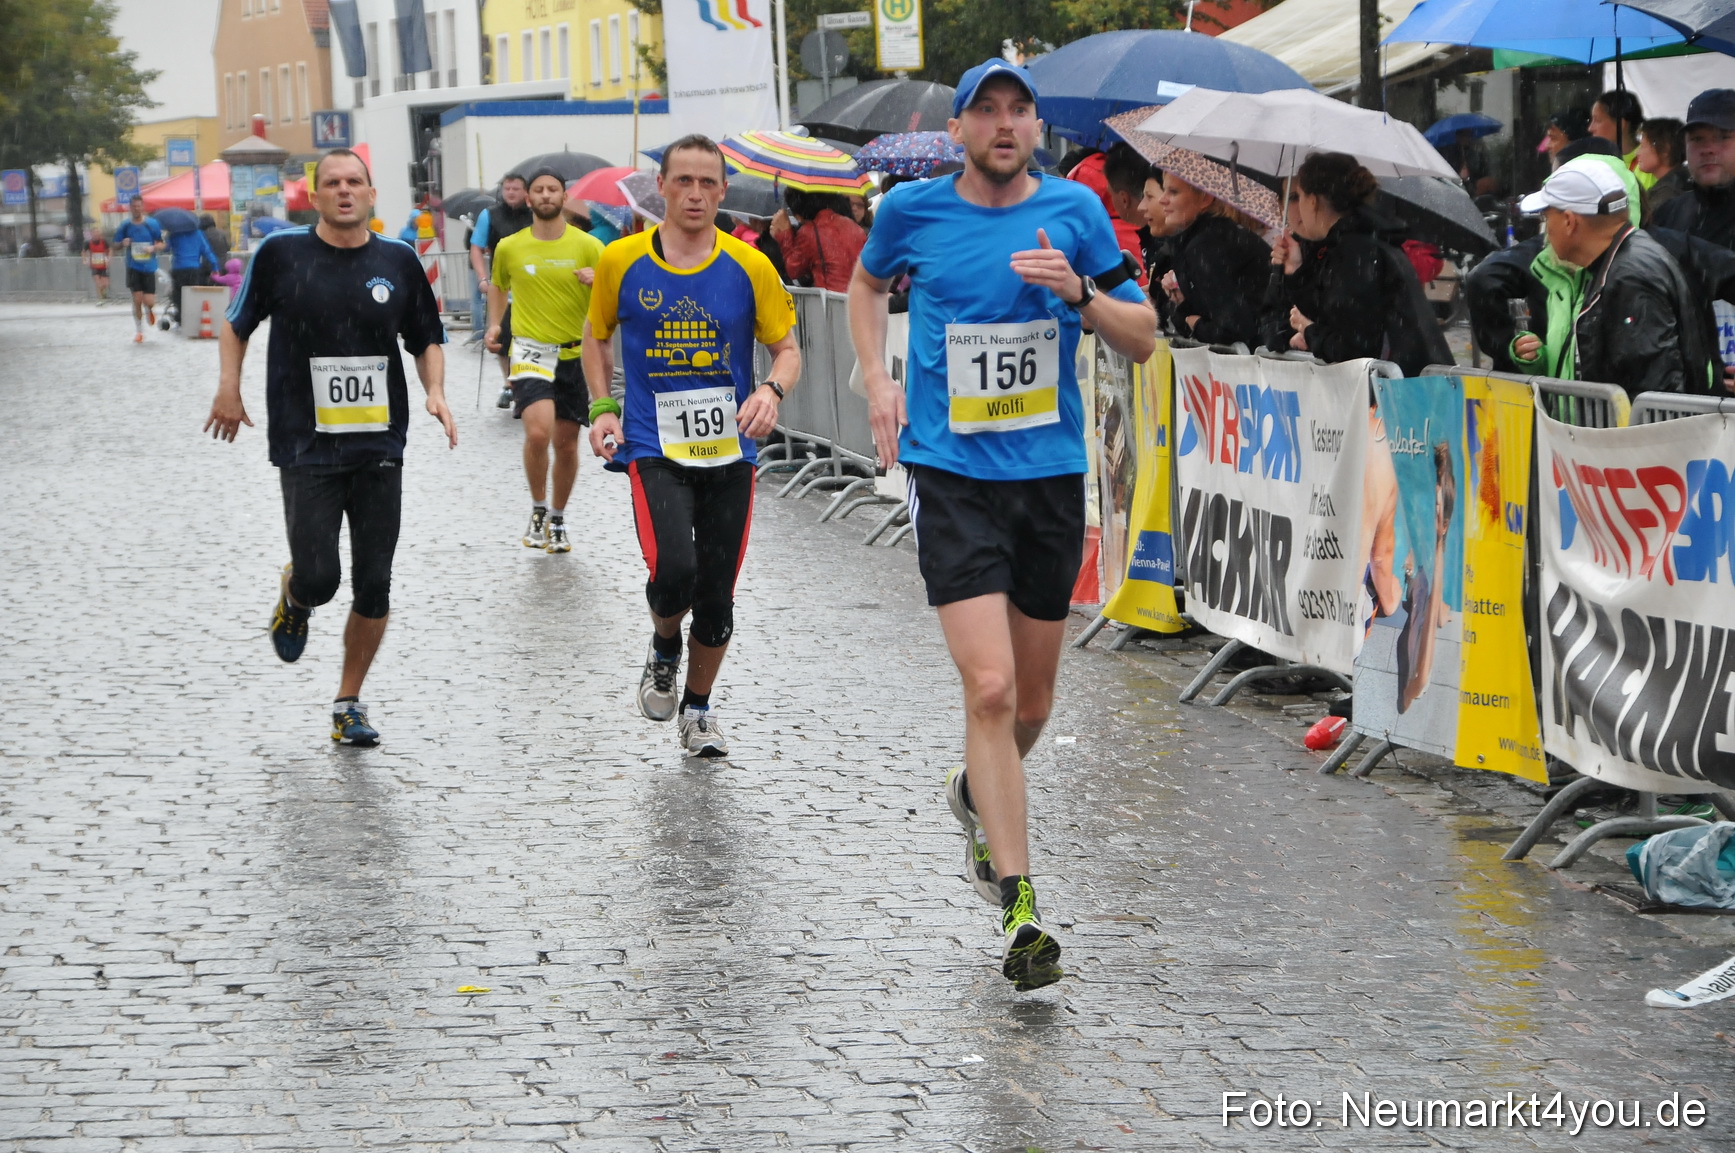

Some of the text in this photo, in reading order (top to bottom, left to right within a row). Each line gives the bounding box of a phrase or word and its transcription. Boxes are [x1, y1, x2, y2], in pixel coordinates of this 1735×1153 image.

[365, 276, 395, 292] adidas
[656, 341, 700, 349] 21.September
[949, 331, 1041, 346] PARTL Neumarkt
[522, 349, 542, 364] 72
[313, 364, 375, 373] PARTL Neumarkt
[517, 364, 540, 373] Tobias
[971, 347, 1037, 390] 156
[329, 375, 375, 404] 604
[658, 395, 724, 409] PARTL Neumarkt
[986, 398, 1024, 417] Wolfi
[676, 407, 725, 438] 159
[689, 444, 718, 457] Klaus
[1298, 589, 1336, 621] 92318
